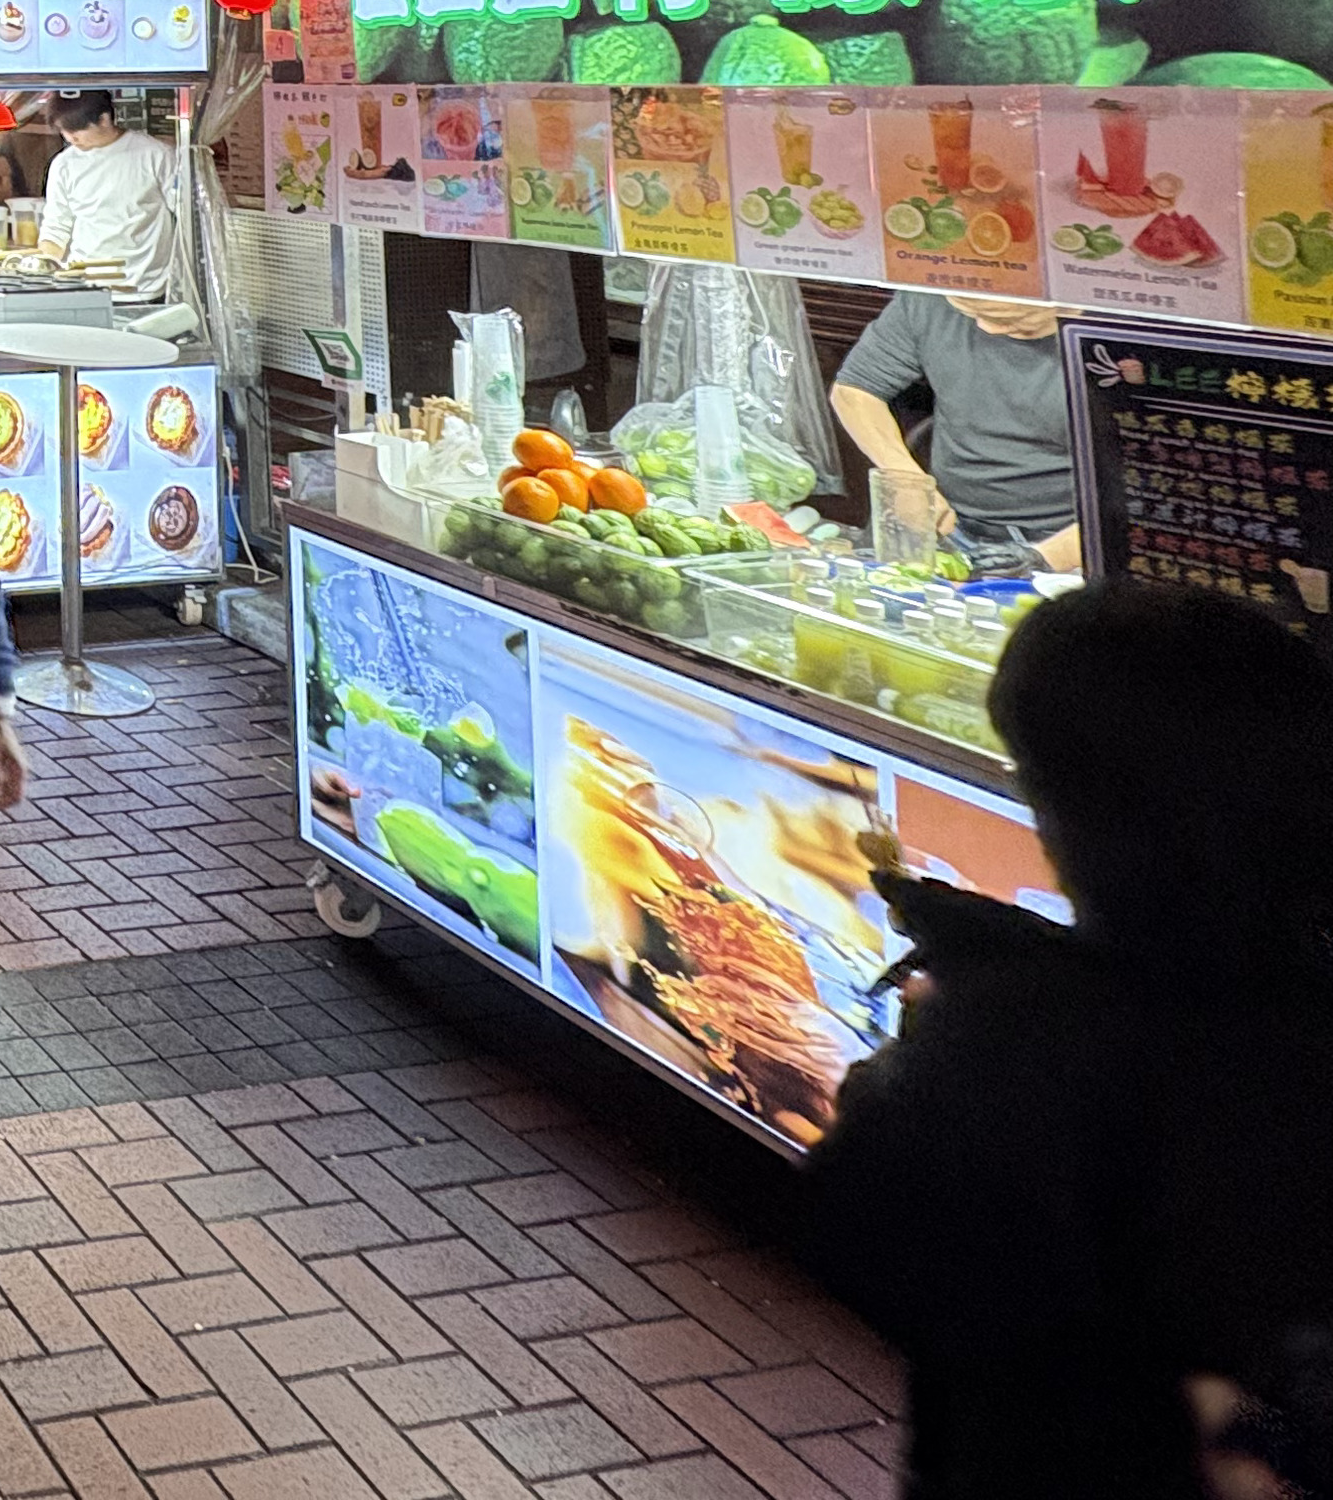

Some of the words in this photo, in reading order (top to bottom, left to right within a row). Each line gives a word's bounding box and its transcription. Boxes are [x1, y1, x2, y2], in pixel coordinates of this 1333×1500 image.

[674, 224, 705, 236] Lemon
[706, 227, 724, 238] Tea
[807, 245, 837, 255] Lemon
[896, 249, 948, 266] Orange
[950, 254, 1001, 269] Lemon
[1002, 259, 1029, 272] tea
[1062, 262, 1142, 281] Watermelon
[1144, 271, 1191, 288] Lemon
[1192, 275, 1218, 291] Tea
